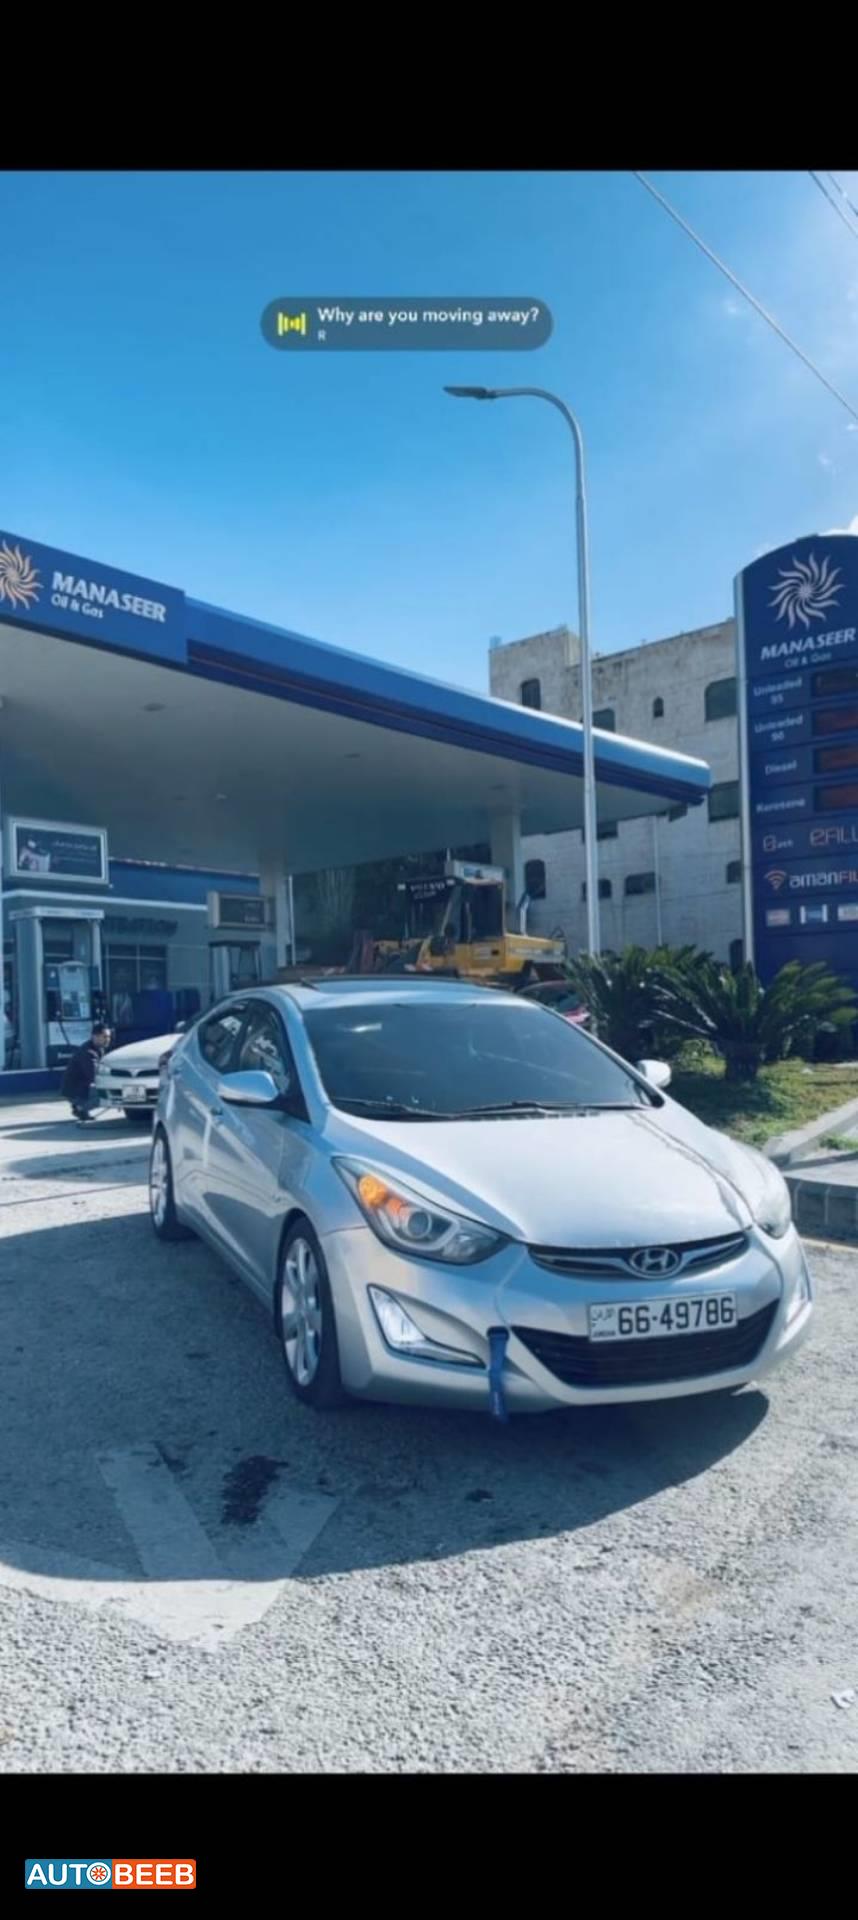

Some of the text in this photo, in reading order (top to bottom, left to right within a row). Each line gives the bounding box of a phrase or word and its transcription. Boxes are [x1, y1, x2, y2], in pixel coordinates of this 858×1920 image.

[51, 594, 68, 609] Oil
[82, 603, 104, 619] Gas
[52, 571, 167, 623] MANASEER
[760, 627, 857, 661] MANASEER
[765, 759, 798, 775] Diesel
[618, 1297, 735, 1335] 66-49786
